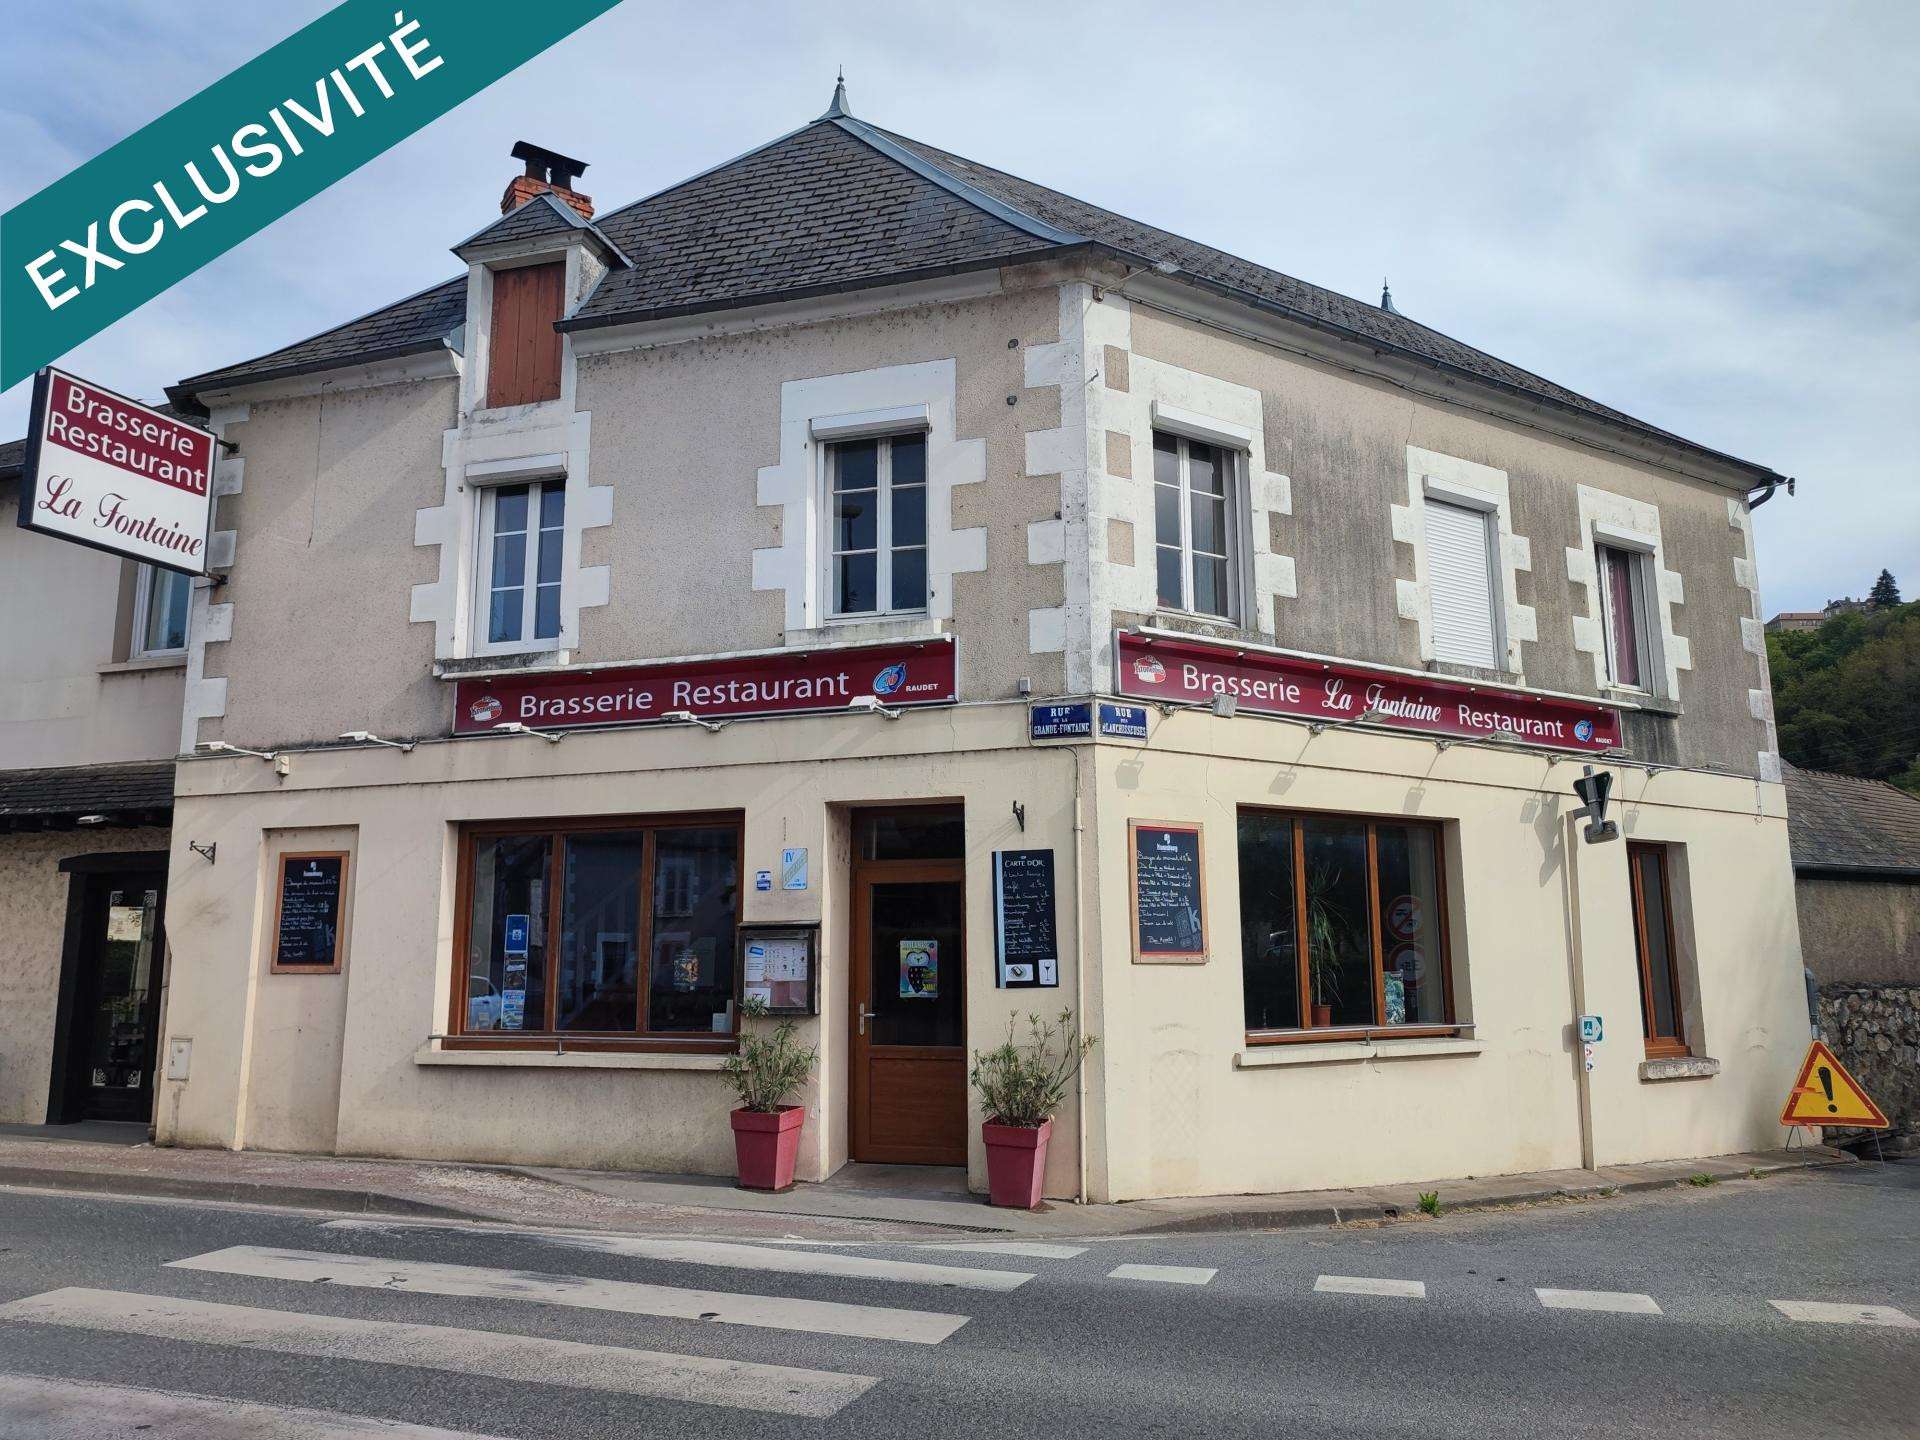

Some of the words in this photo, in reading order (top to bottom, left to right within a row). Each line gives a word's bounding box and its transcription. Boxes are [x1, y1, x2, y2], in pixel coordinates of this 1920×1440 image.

[66, 384, 195, 457] Brasserie
[49, 410, 206, 491] Restaurant
[38, 474, 82, 520] La
[93, 492, 203, 557] Fontaine
[520, 687, 653, 718] Brasserie
[673, 671, 850, 707] Restaurant
[905, 683, 939, 692] RAUDET
[1183, 663, 1300, 704] Brasserie
[1321, 678, 1353, 711] La
[1363, 683, 1442, 722] Fontaine
[1458, 703, 1564, 739] Restaurant
[1050, 706, 1070, 717] RUE
[1114, 707, 1132, 718] RUE
[1004, 860, 1025, 868] CARTE
